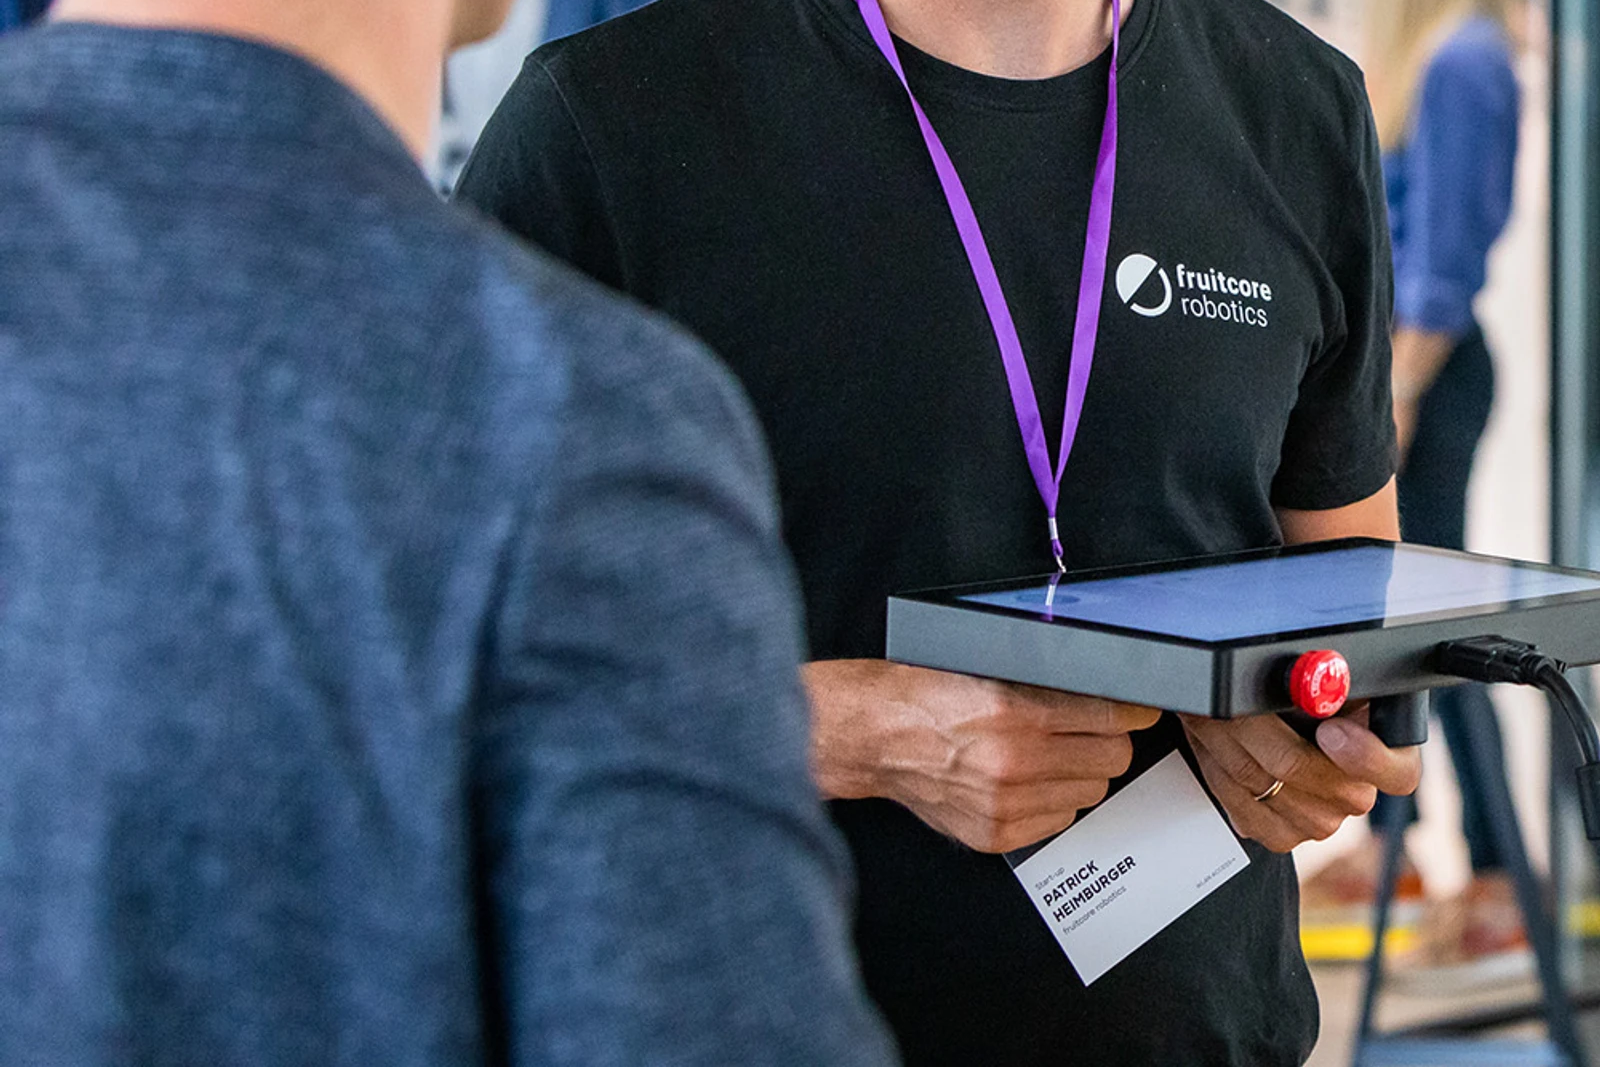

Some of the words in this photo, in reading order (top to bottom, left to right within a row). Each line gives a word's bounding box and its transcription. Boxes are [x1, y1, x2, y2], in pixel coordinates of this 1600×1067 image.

[1176, 263, 1272, 301] fruitcore
[1181, 294, 1268, 327] robotics
[1035, 867, 1065, 890] Start-up
[1043, 860, 1099, 906] PATRICK
[1053, 855, 1136, 922] HEIMBURGER
[1063, 908, 1096, 935] fruitcore
[1096, 886, 1127, 911] robotics
